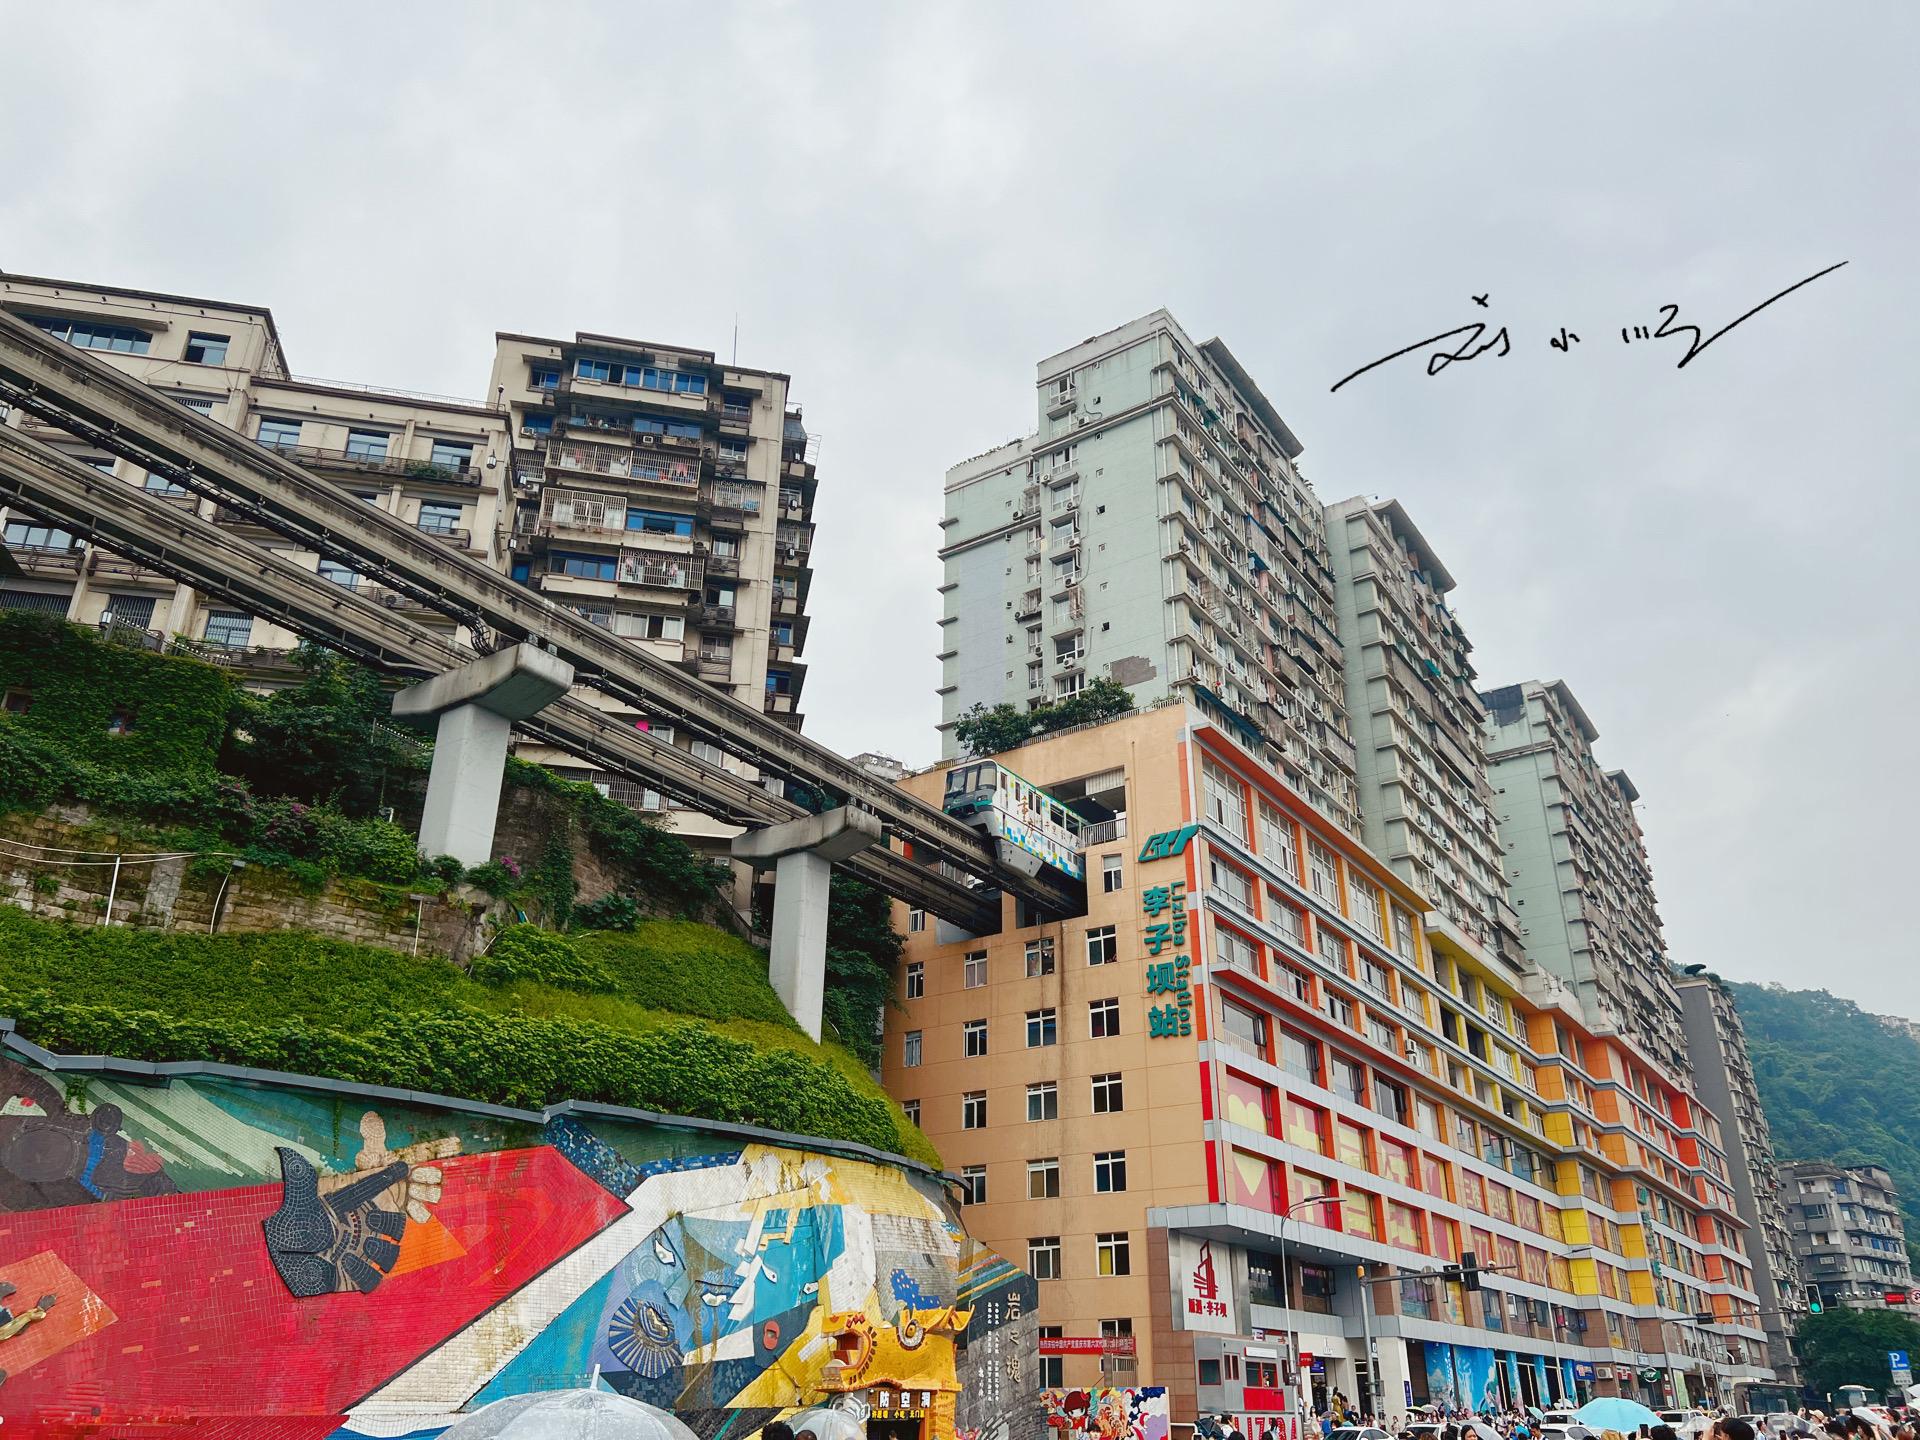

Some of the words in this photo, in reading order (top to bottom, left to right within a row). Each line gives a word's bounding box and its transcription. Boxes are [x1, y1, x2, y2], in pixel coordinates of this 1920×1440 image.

[1143, 885, 1181, 1038] 李子坝站
[1174, 955, 1193, 1036] Station
